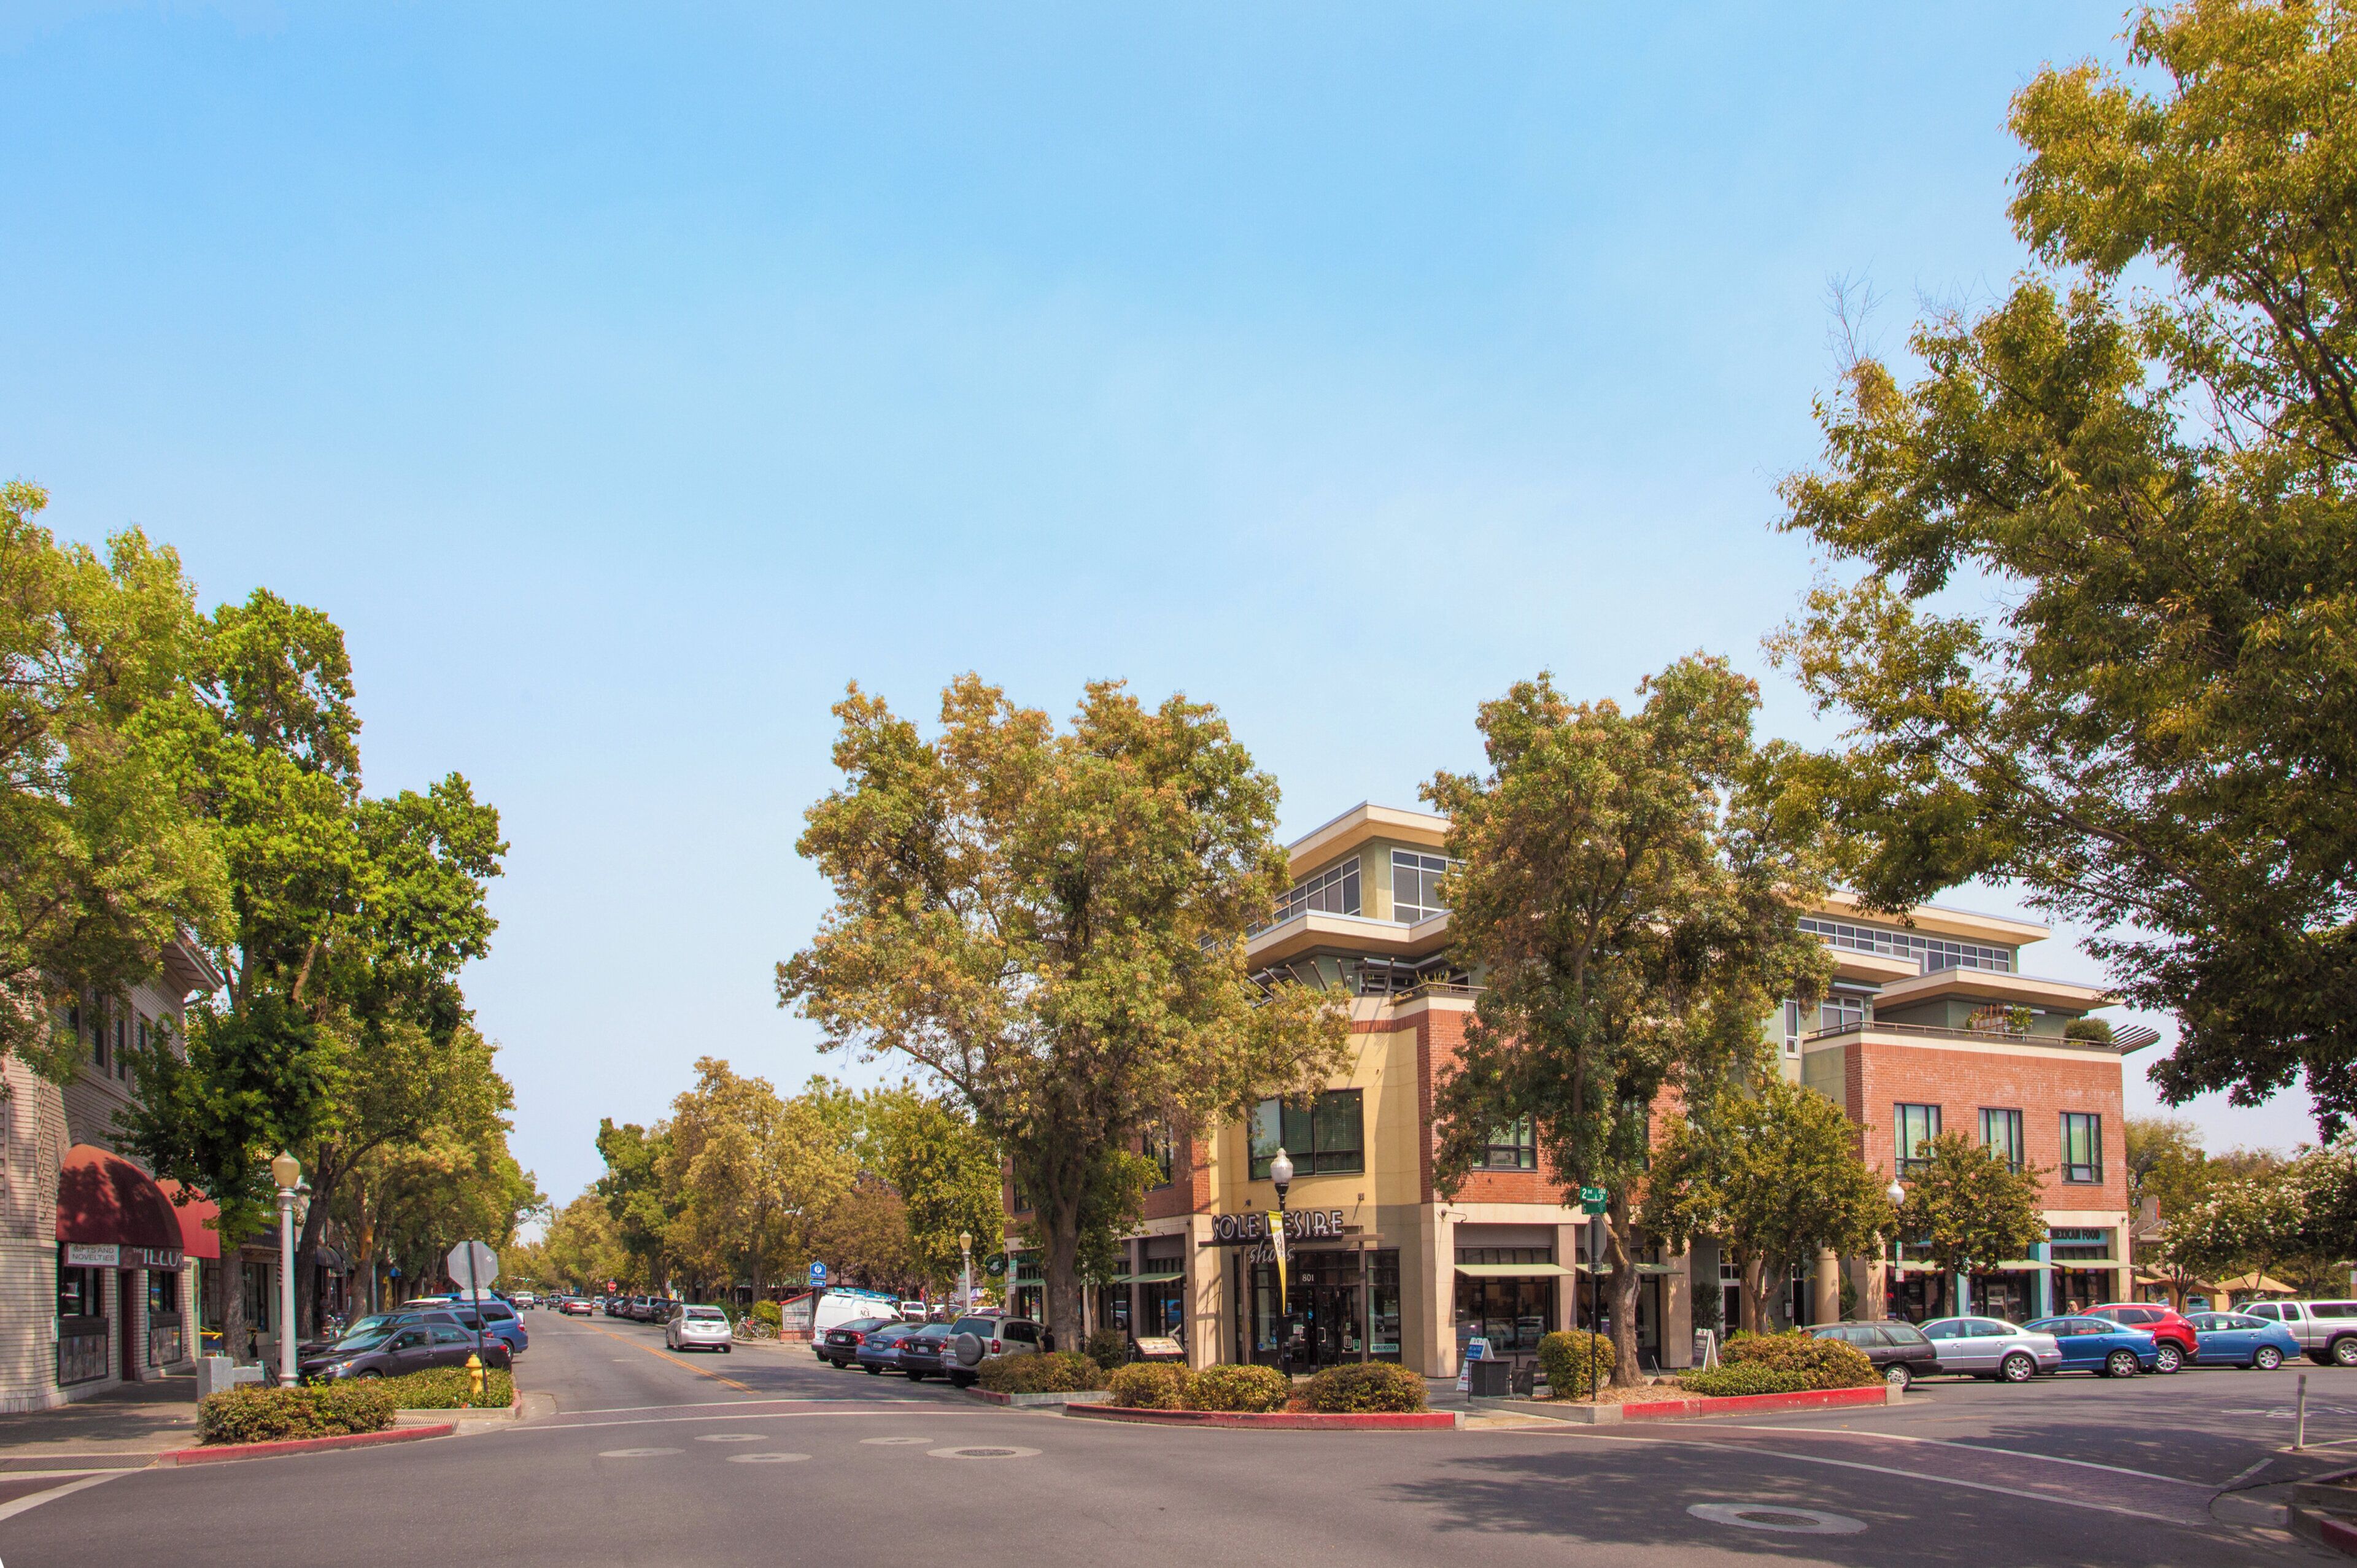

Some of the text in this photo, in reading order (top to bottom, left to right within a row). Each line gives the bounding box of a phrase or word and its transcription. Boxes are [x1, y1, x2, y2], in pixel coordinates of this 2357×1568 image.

[1212, 1215, 1258, 1240] SOLE
[2082, 1229, 2100, 1240] FOOD
[1250, 1240, 1294, 1264] shos
